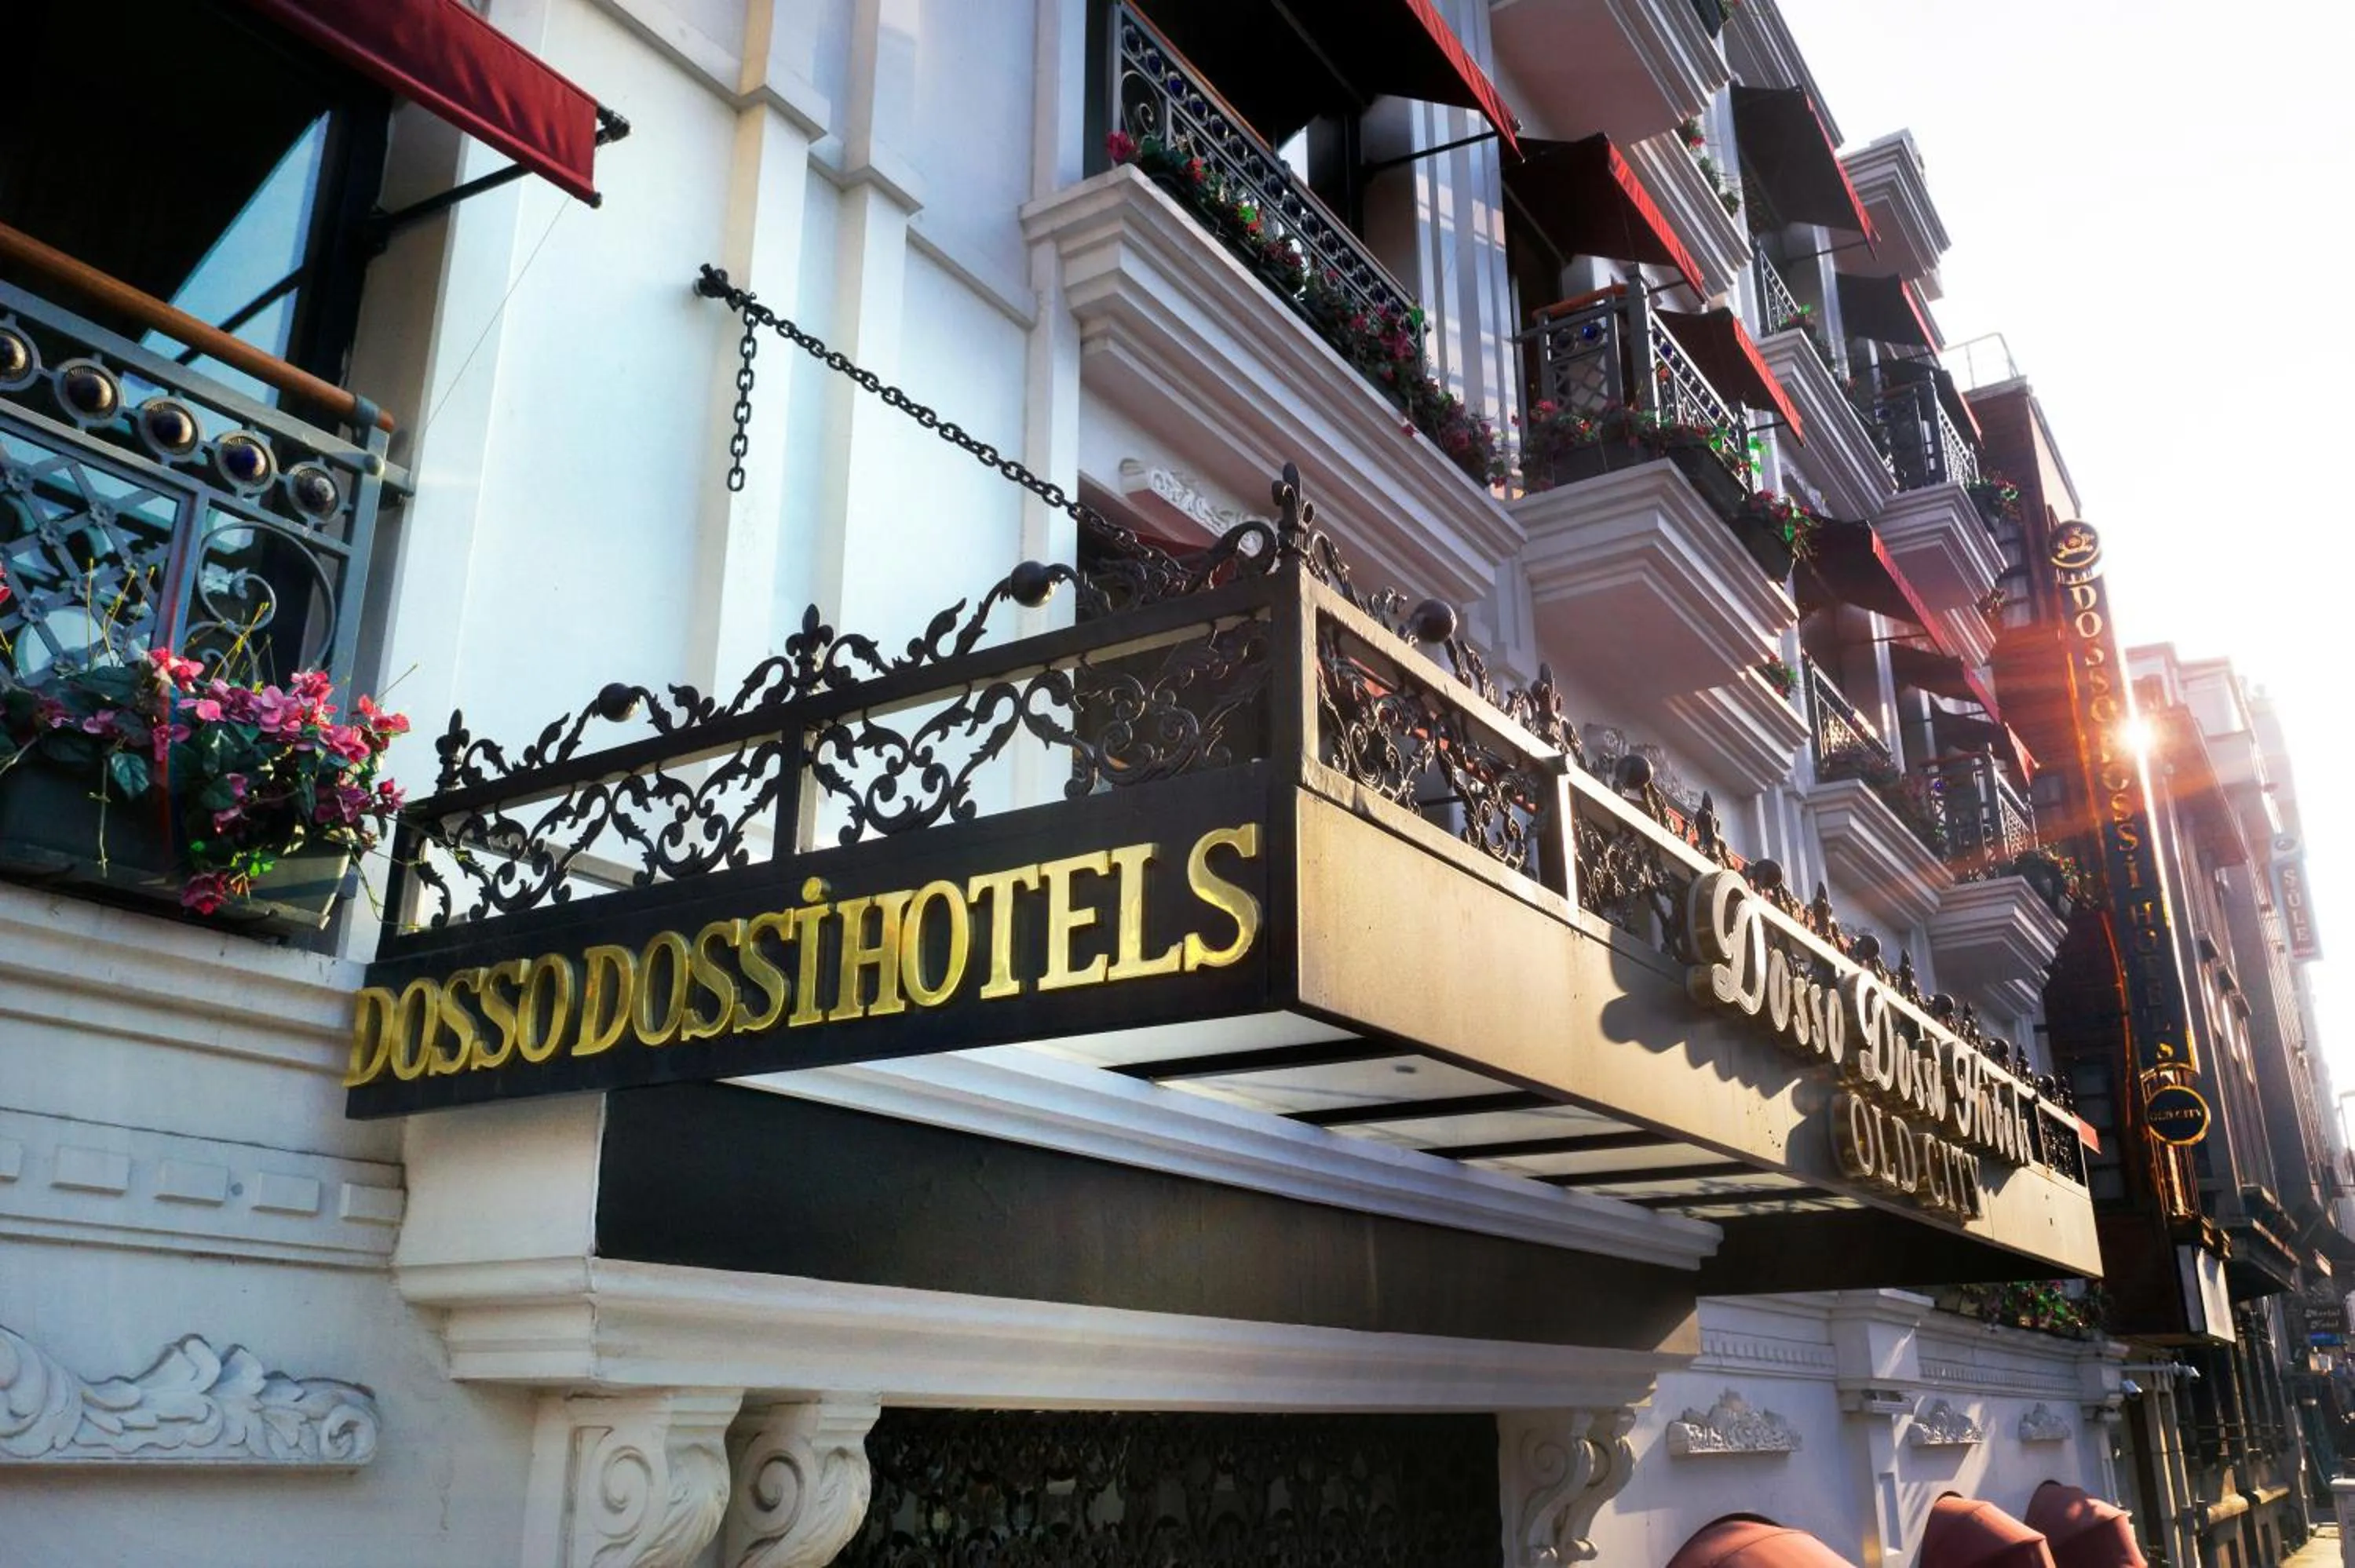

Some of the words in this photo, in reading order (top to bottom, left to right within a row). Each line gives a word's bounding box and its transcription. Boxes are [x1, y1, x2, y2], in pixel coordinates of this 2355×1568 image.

[2069, 584, 2117, 722] DOSSO
[344, 952, 575, 1087] DOSSO
[826, 822, 1262, 1023] HOTELS
[1703, 870, 1845, 1064] Dosso
[1849, 1093, 1918, 1194] OLD
[1924, 1132, 1982, 1219] CITY
